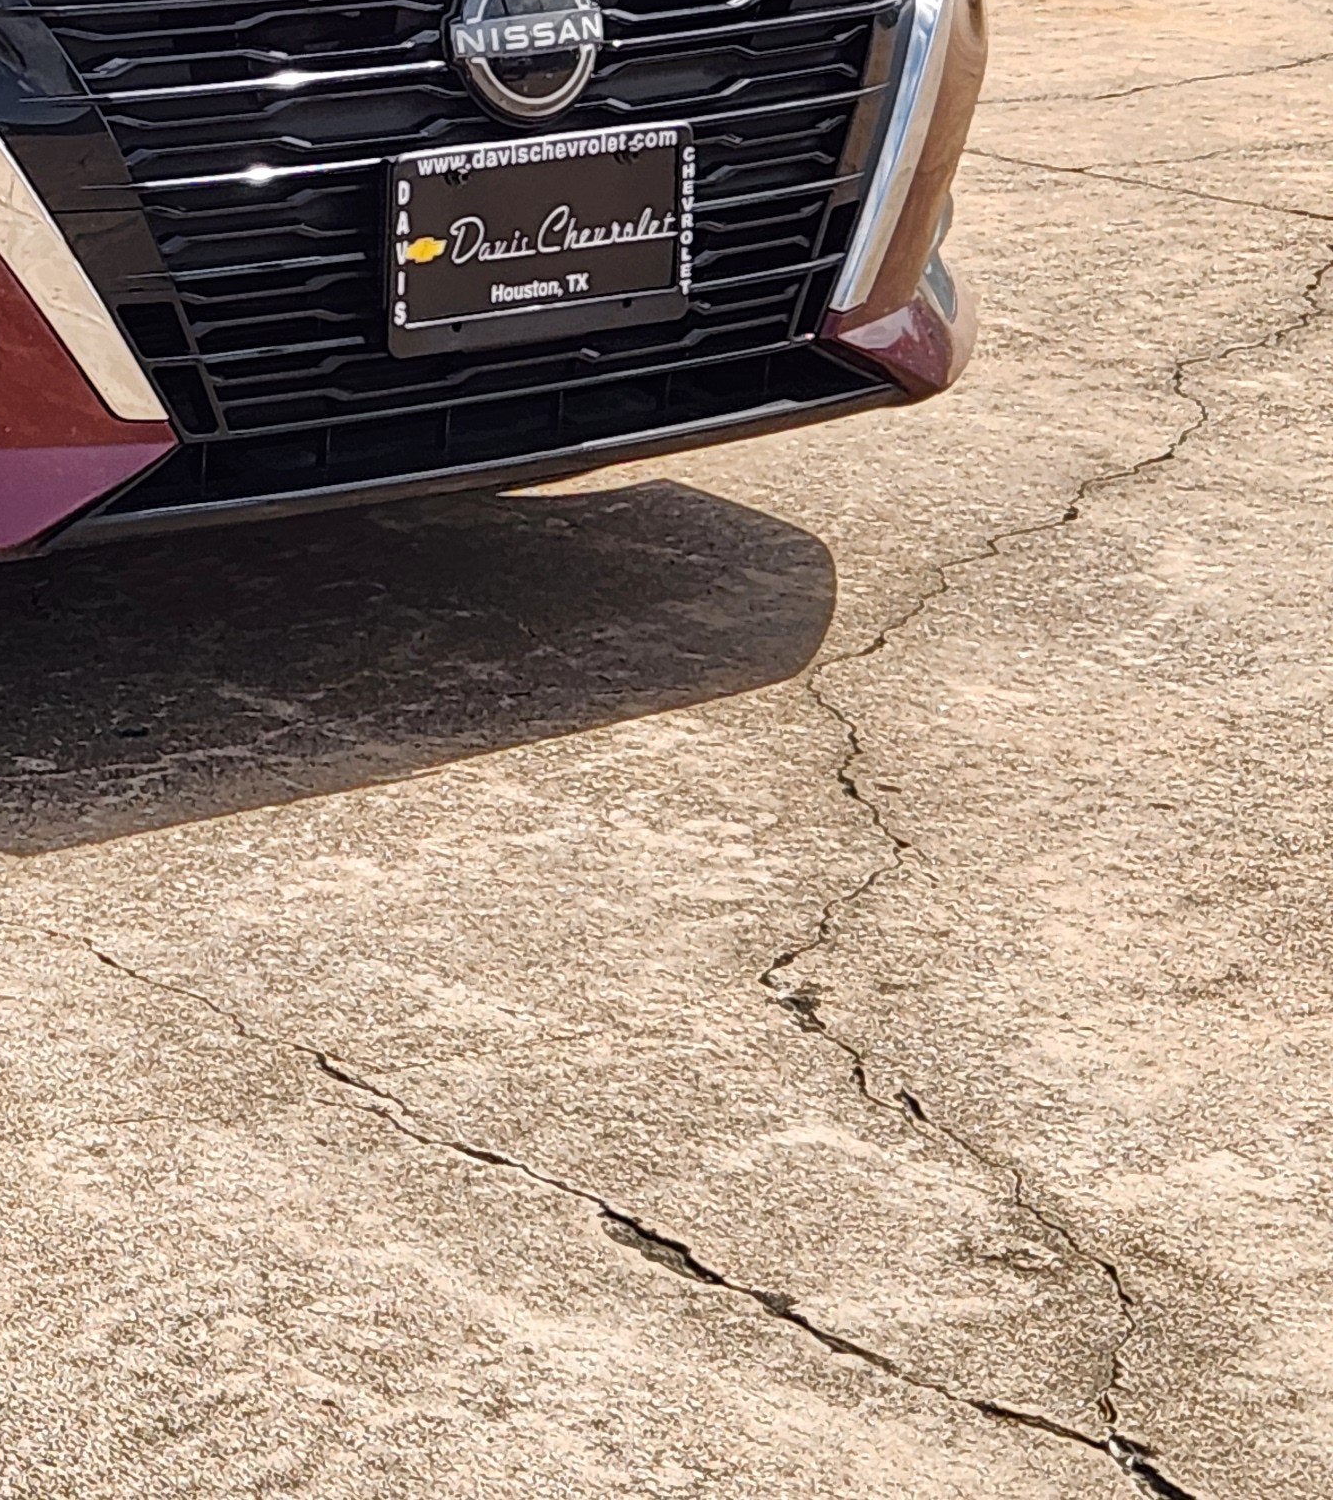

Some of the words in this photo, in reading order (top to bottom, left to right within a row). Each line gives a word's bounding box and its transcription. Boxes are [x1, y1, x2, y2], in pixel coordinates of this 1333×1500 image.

[456, 13, 603, 56] NISSAN
[417, 130, 677, 176] www.davischevrolet.com
[450, 215, 536, 264] Davis
[537, 204, 679, 254] Chevrolet
[679, 146, 696, 296] CHEVROLET
[394, 180, 411, 327] DAVIS
[491, 278, 564, 304] Houston,
[566, 273, 589, 293] TX
